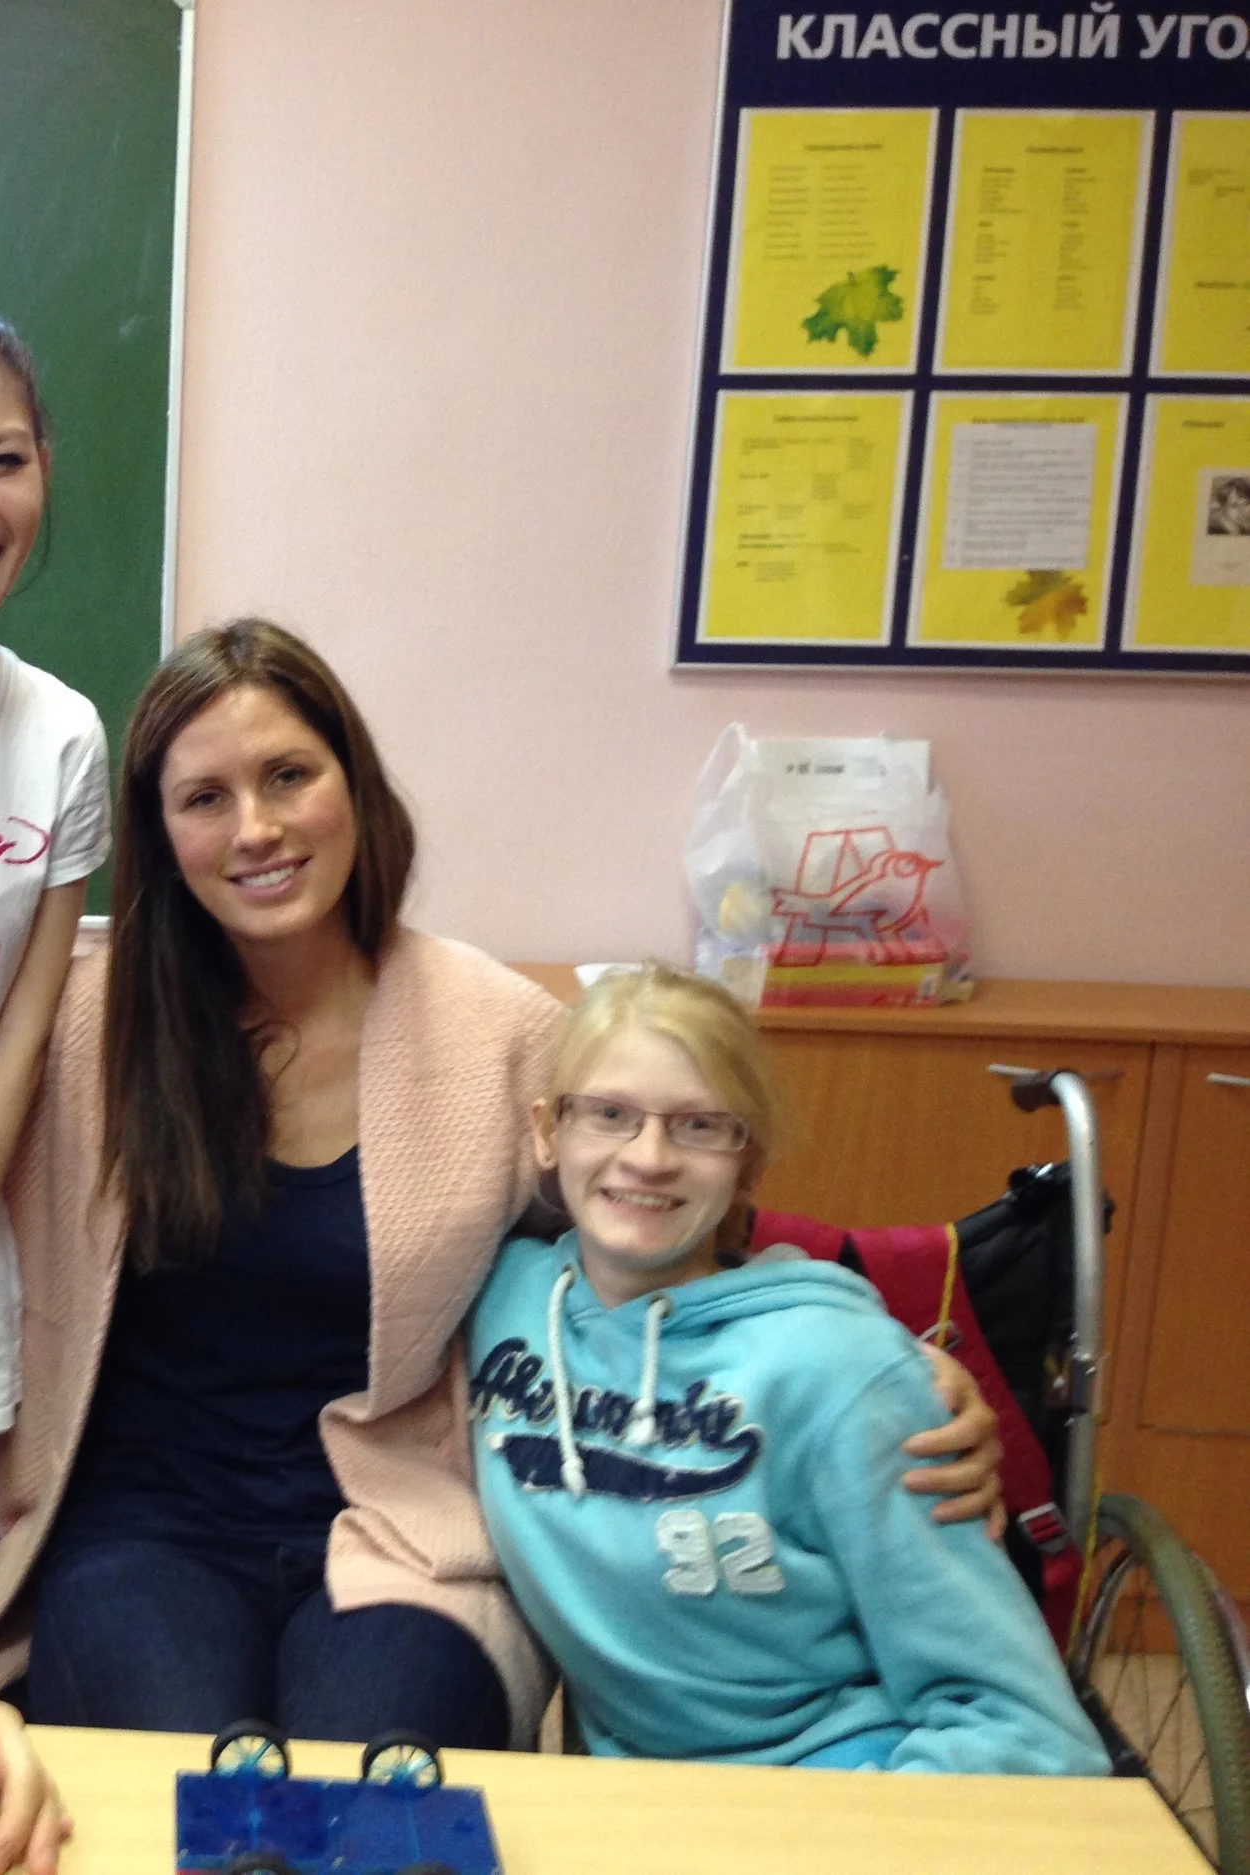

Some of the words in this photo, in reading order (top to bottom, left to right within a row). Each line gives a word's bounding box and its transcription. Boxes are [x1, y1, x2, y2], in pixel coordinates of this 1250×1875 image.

[776, 2, 1121, 60] КЛАССНЫЙ
[1136, 13, 1250, 60] УГО
[655, 1509, 787, 1597] 92
